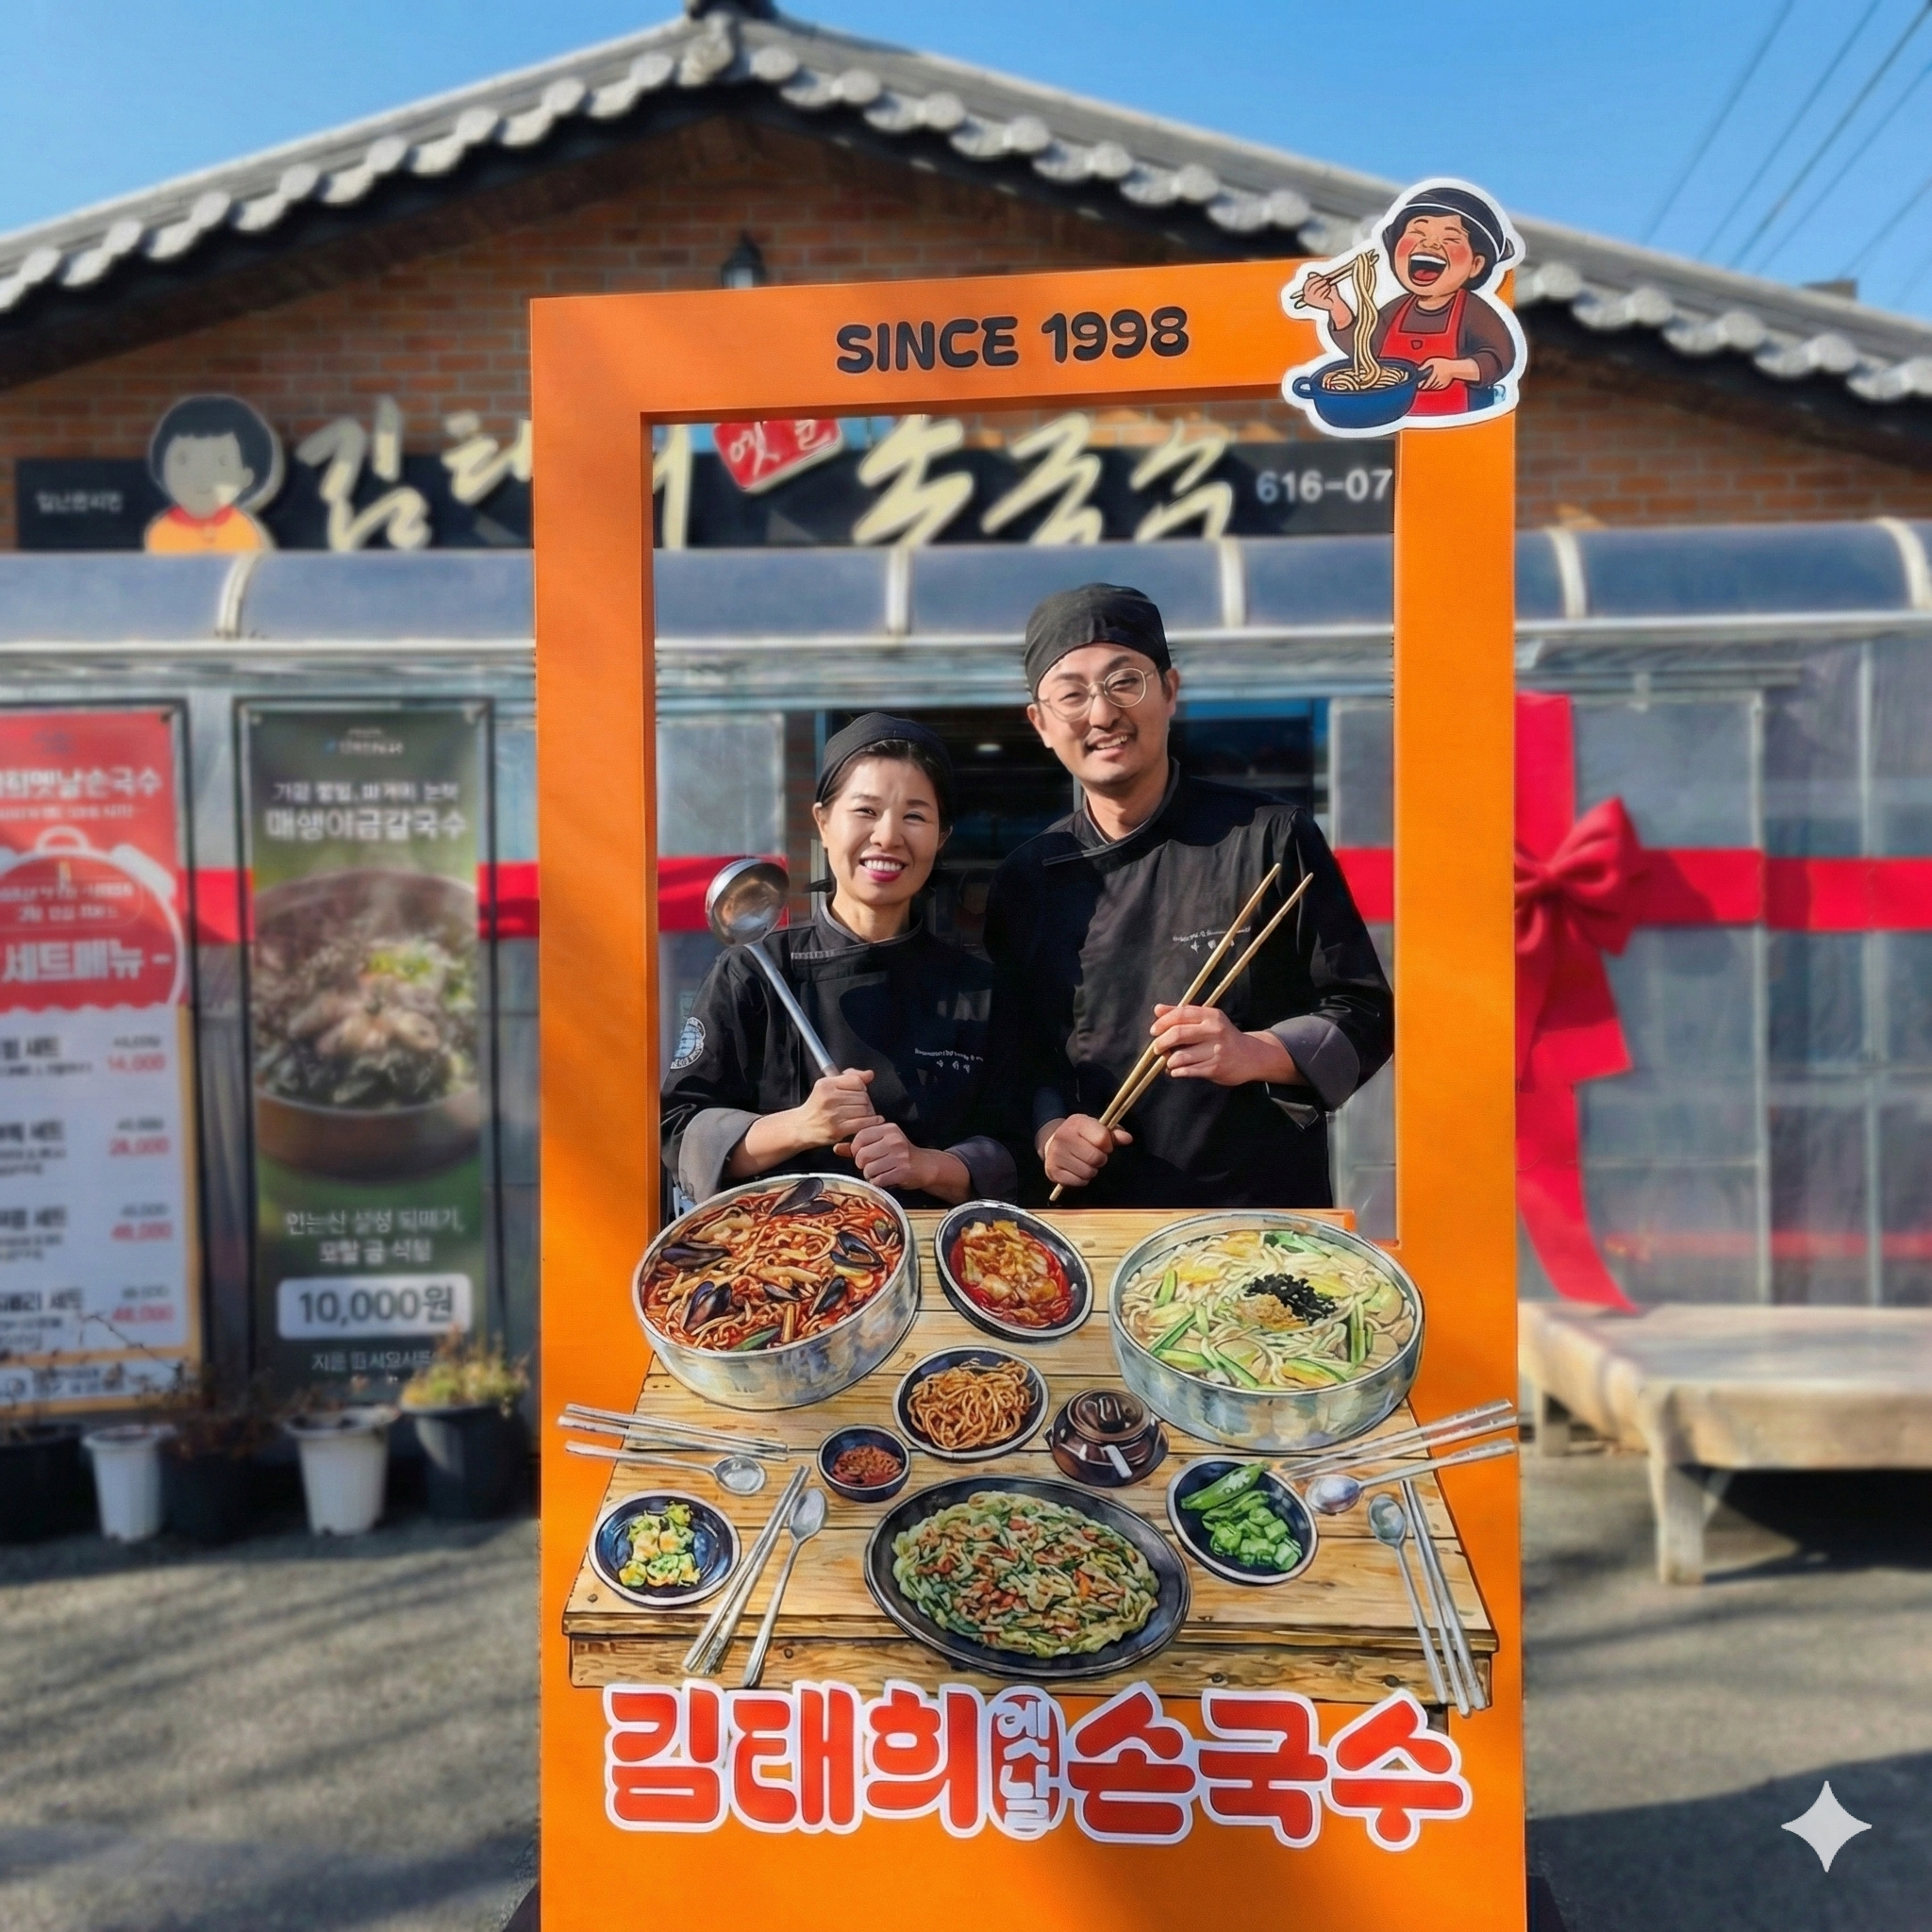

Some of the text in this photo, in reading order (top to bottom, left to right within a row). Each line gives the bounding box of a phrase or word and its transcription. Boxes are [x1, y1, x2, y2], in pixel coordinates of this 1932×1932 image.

[837, 306, 1190, 374] SINCE 1998
[299, 1286, 454, 1326] 10,000원
[608, 1686, 980, 1832] 김태희
[1065, 1684, 1465, 1844] 손국수
